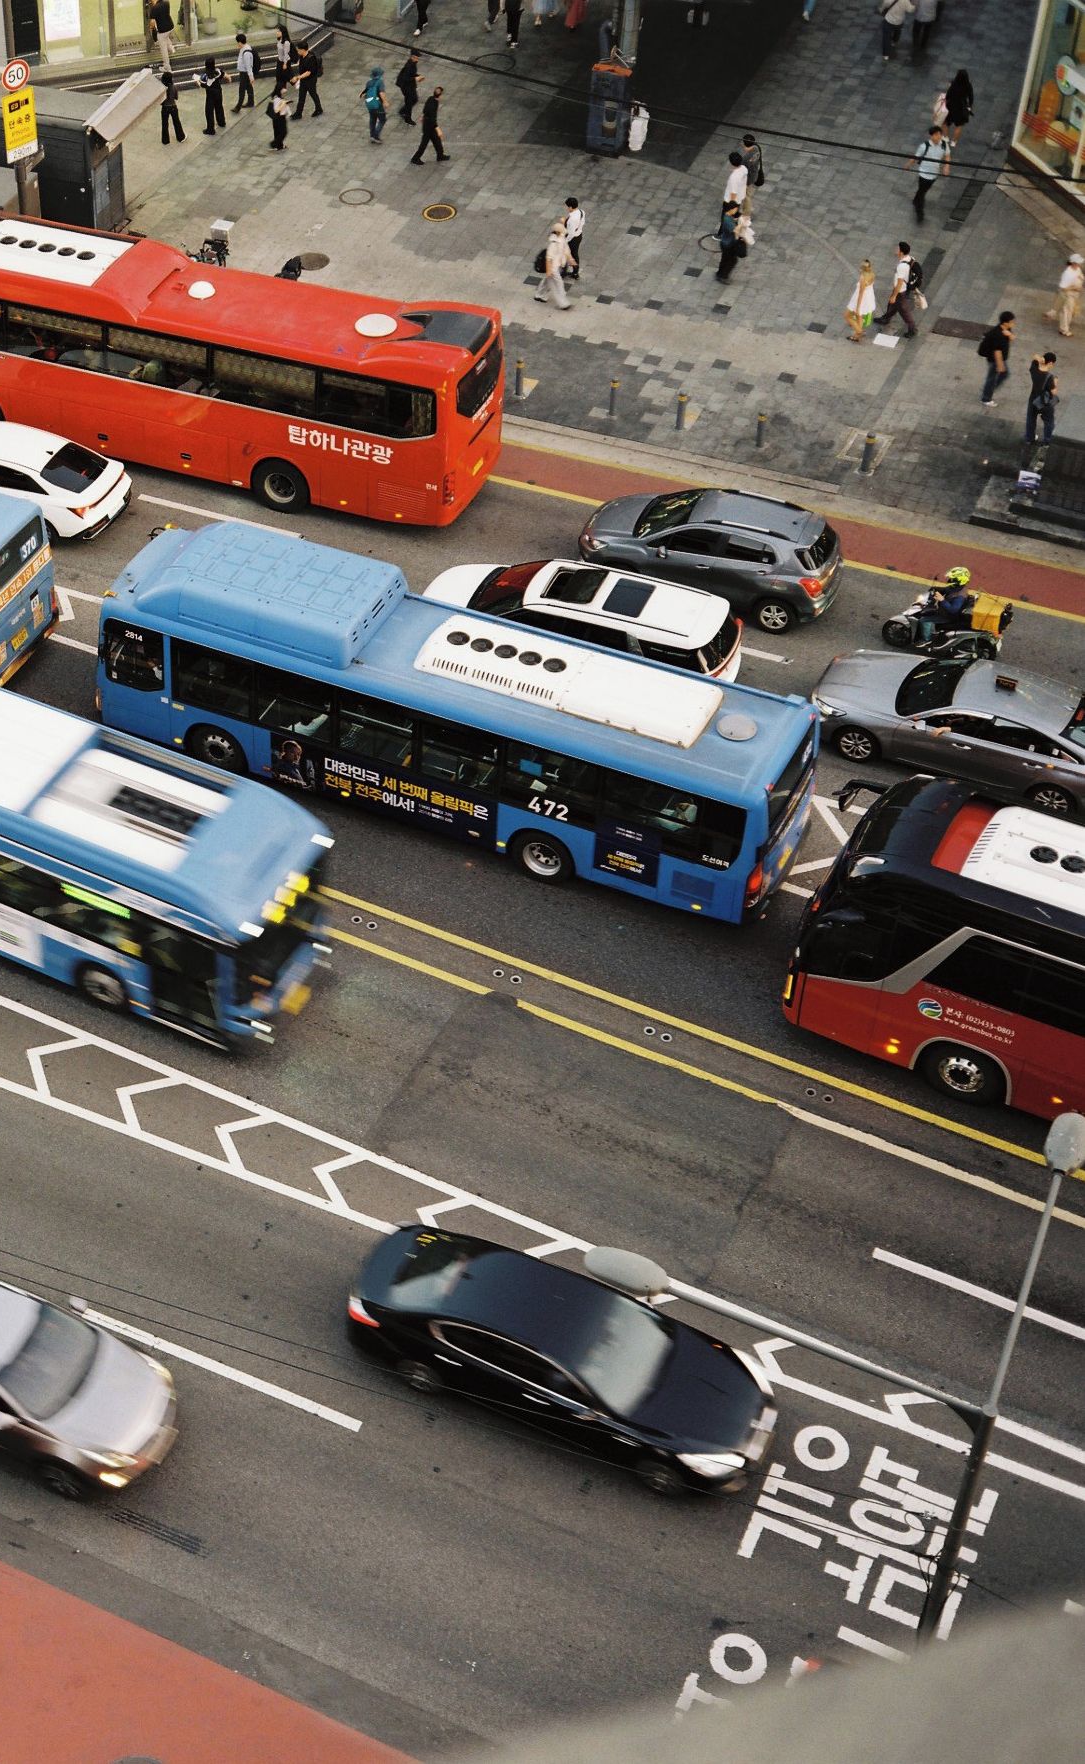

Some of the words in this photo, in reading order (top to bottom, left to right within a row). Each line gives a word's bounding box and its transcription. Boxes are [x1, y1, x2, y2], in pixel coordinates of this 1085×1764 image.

[8, 67, 24, 84] 50
[287, 424, 394, 465] 탑하나관광
[21, 536, 36, 559] 370
[125, 630, 143, 642] 2814
[324, 757, 380, 786] 대한민국
[382, 776, 396, 791] 세
[399, 780, 428, 801] 번째
[430, 791, 489, 821] 올림픽은
[324, 773, 352, 792] 전북
[355, 782, 415, 813] 전주에서!
[528, 796, 569, 821] 472
[943, 1017, 1013, 1044] www.greenbus.co.kr
